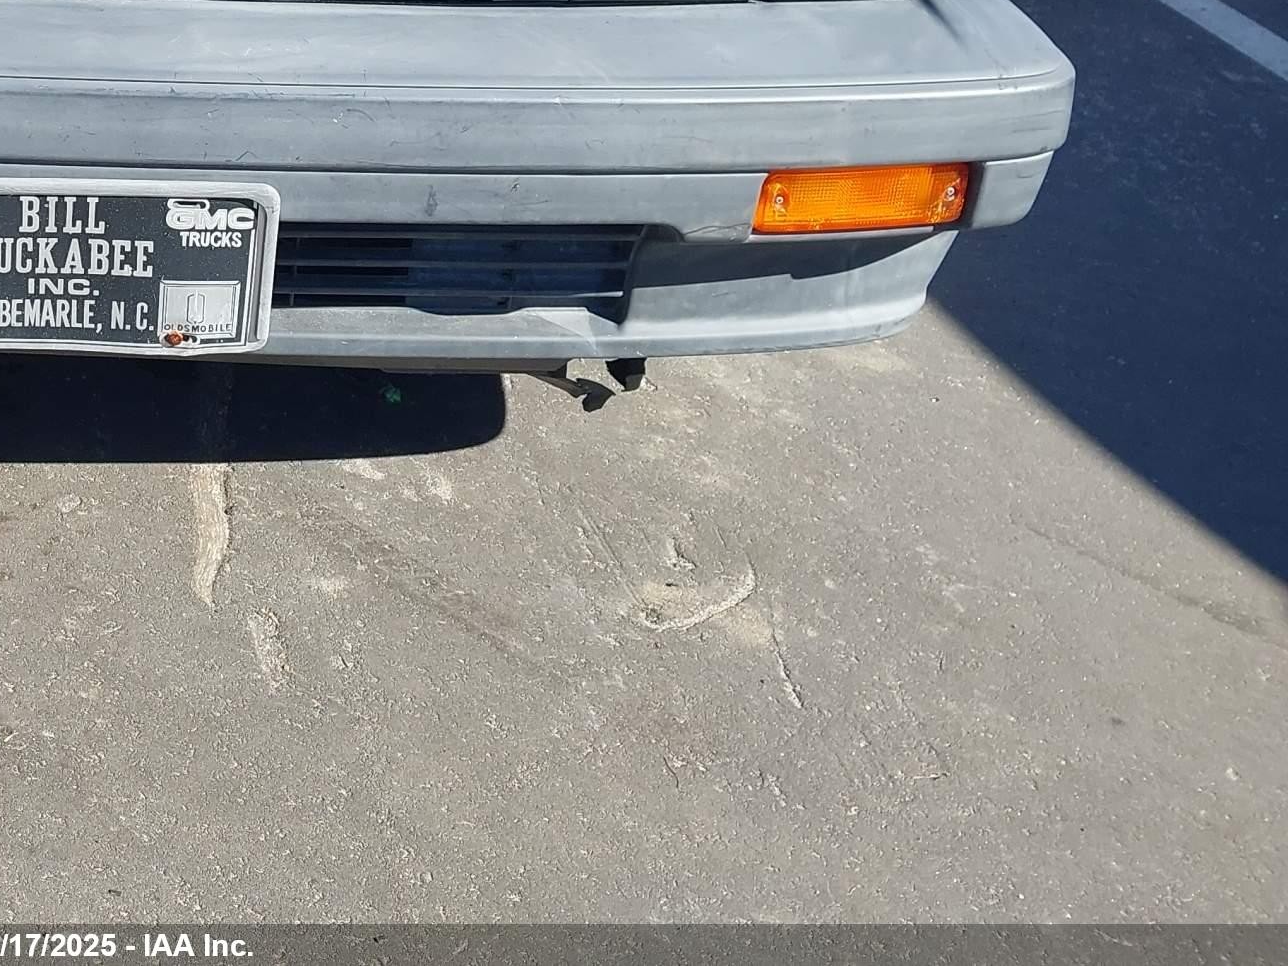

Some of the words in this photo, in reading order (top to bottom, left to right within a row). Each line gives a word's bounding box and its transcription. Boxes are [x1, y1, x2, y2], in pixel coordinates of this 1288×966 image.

[19, 196, 105, 234] BILL
[166, 207, 255, 230] GMC
[180, 231, 242, 248] TRUCKS
[27, 278, 100, 296] INC.
[163, 323, 232, 333] OLDSMOBILE
